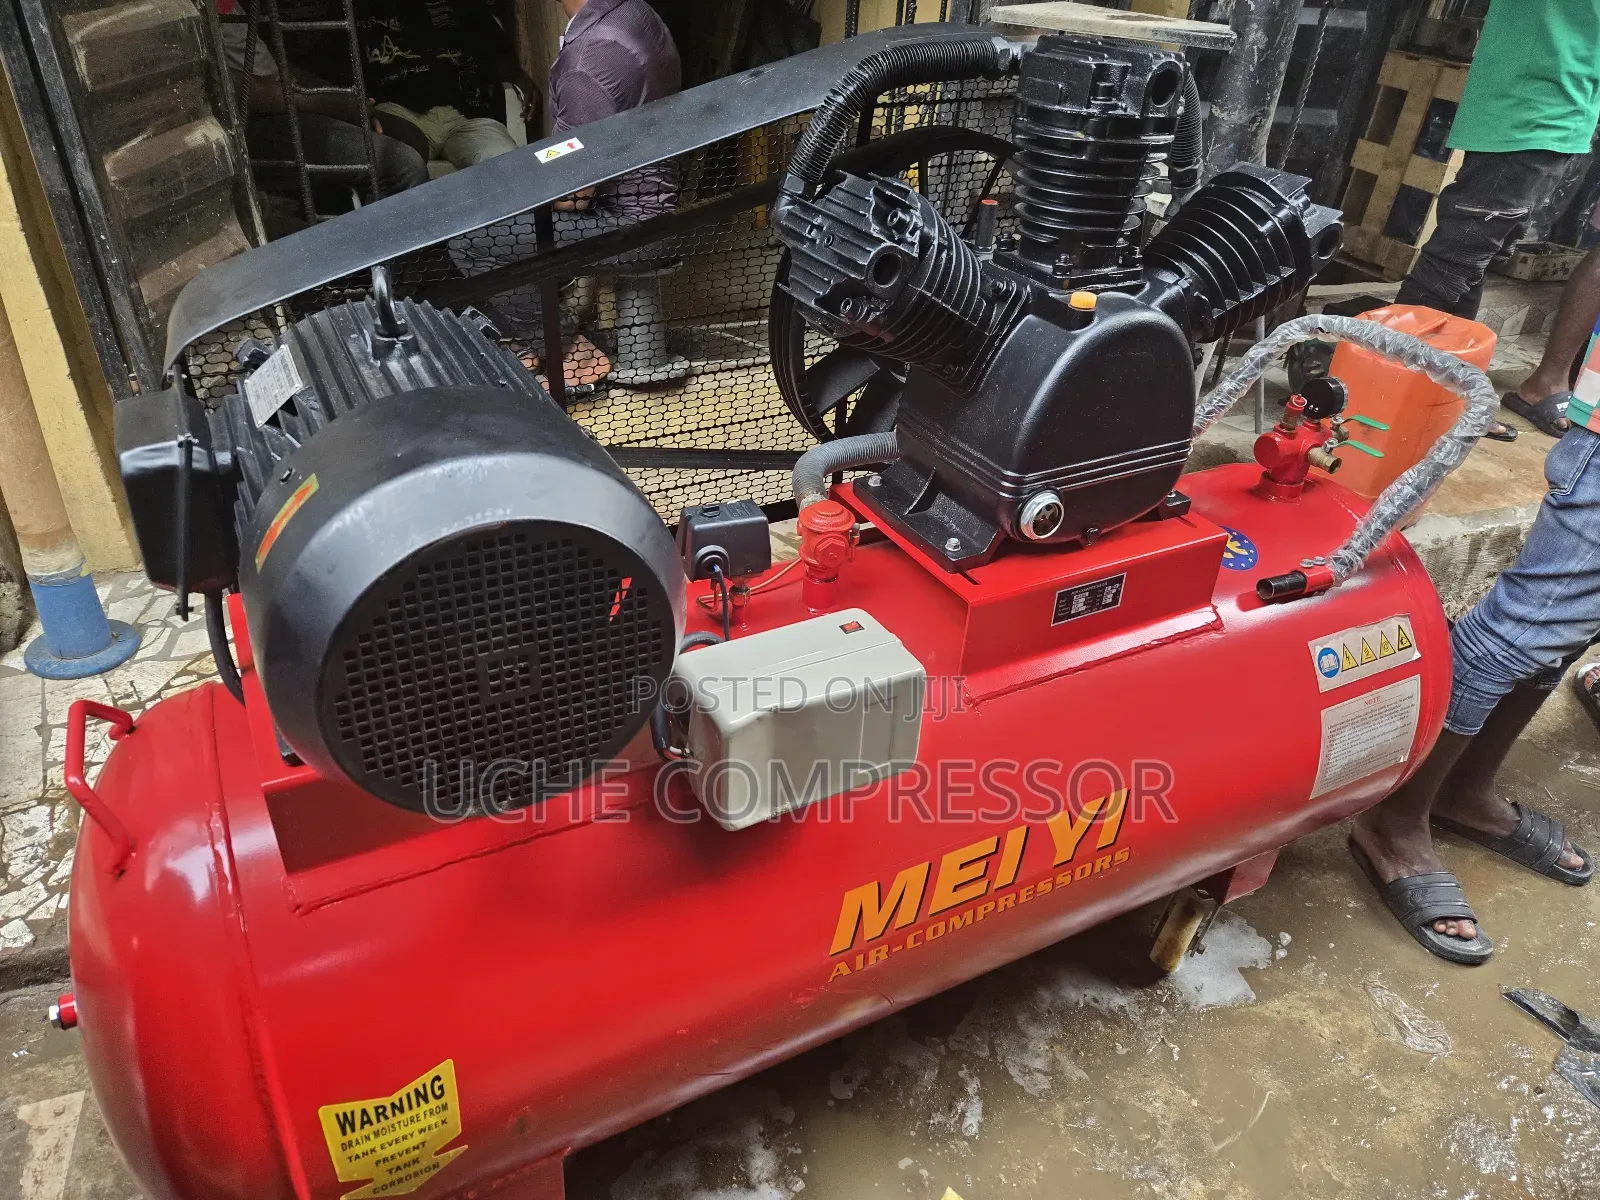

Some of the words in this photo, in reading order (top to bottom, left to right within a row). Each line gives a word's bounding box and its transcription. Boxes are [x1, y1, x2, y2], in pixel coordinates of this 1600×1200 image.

[1364, 696, 1381, 706] NOTE
[829, 824, 1031, 957] MEI
[1045, 787, 1130, 869] YI
[827, 846, 1132, 983] AIR-COMPRESSORS
[334, 1074, 446, 1137] WARNING
[340, 1133, 371, 1152] DRAIN
[373, 1113, 421, 1140] MOISTURE
[423, 1102, 449, 1119] FROM
[346, 1147, 377, 1163] TANK
[380, 1131, 415, 1150] EVERY
[418, 1117, 449, 1134] WEEK
[374, 1141, 428, 1167] PREVENT
[372, 1161, 441, 1195] CORROSION
[386, 1156, 421, 1176] TANK
